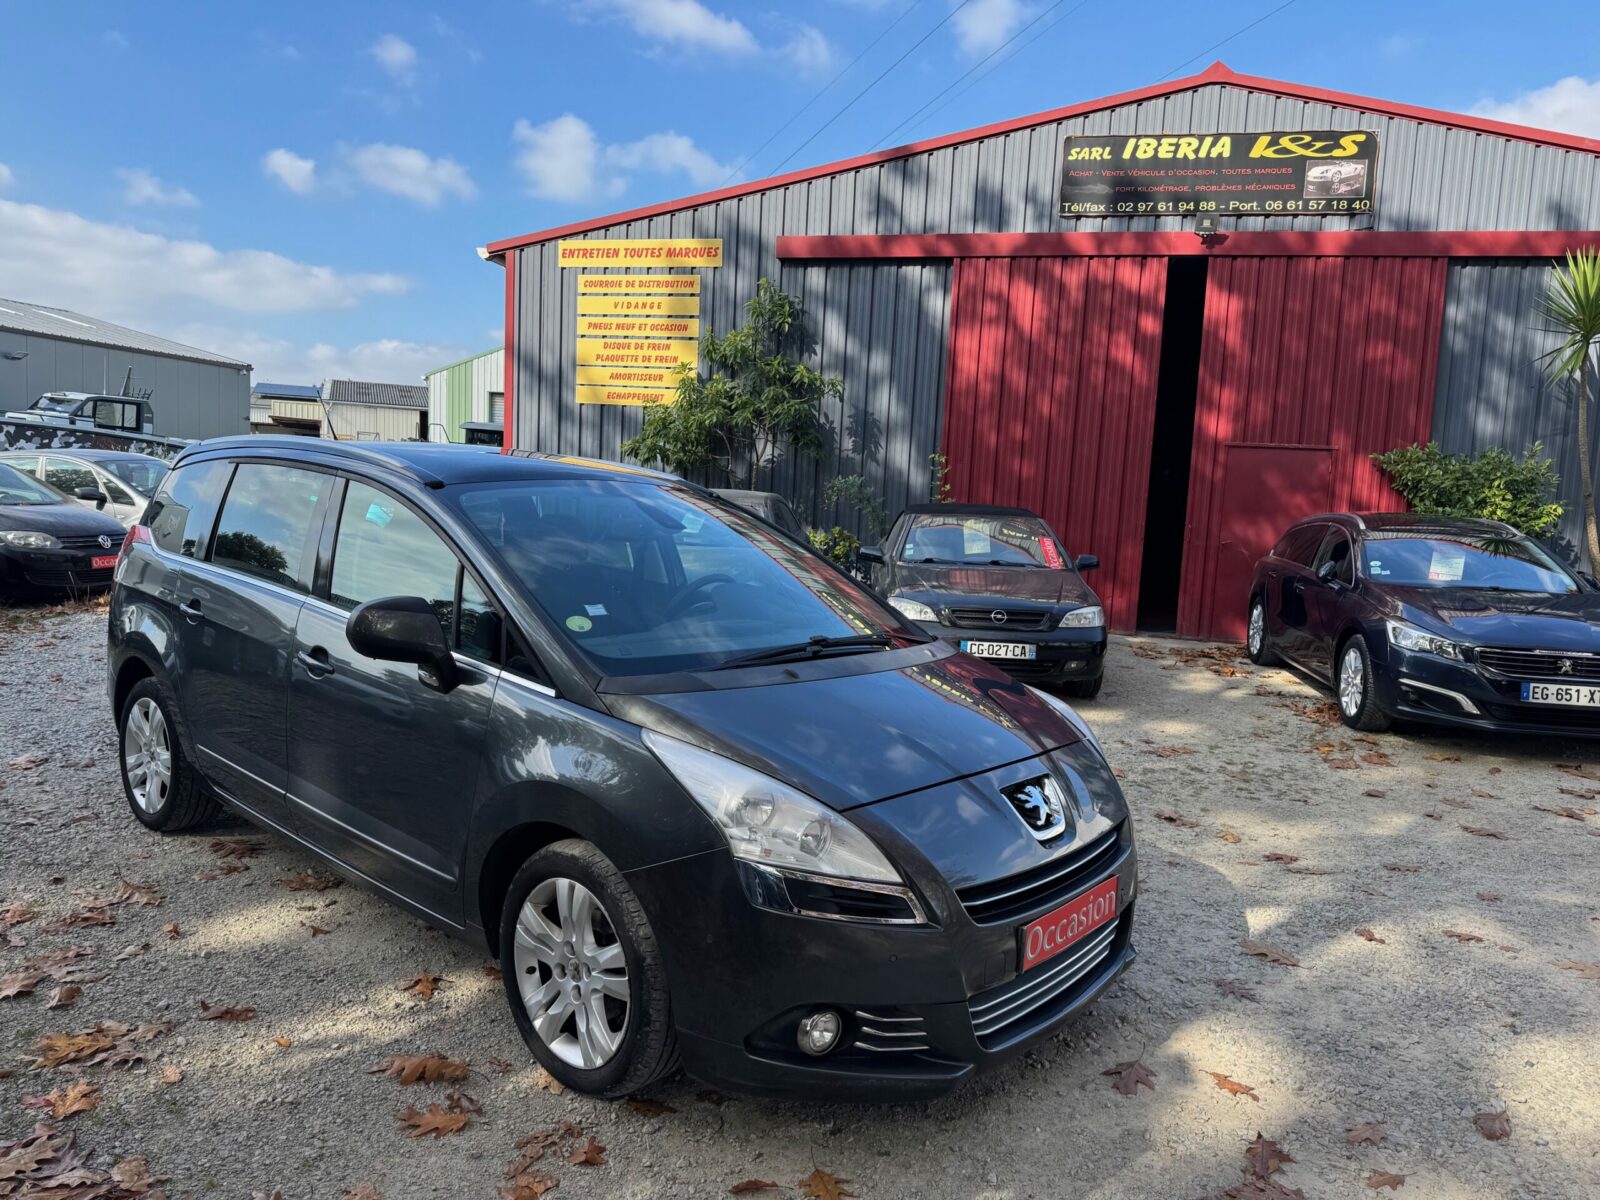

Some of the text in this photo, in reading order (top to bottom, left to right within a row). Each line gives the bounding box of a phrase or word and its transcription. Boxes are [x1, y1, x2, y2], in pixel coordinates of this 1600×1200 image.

[1067, 147, 1112, 161] SARL
[1122, 136, 1231, 160] IBERIA
[1255, 167, 1293, 175] MARQUES
[1194, 183, 1242, 192] PROBLÈMES
[1245, 182, 1296, 191] MÉCANIQUES
[1062, 202, 1106, 213] Tél/fax
[1117, 202, 1134, 212] 02
[1137, 202, 1154, 212] 97
[1157, 202, 1173, 212] 61
[1178, 201, 1195, 211] 94
[1199, 201, 1216, 211] 88
[1229, 201, 1261, 211] Port.
[1265, 200, 1283, 210] 06
[1286, 200, 1303, 210] 61
[1308, 200, 1325, 210] 57
[1332, 200, 1348, 210] 18
[1352, 200, 1370, 210] 40
[561, 247, 719, 259] ENTRETIEN TOUTES MARQUES
[583, 280, 695, 288] COURROIE DE DISTRIBUTION
[613, 301, 663, 310] VIDANGE
[587, 322, 689, 332] PNEUS NEUF ET OCCASION
[603, 341, 671, 351] DISQUE DE FREIN
[595, 354, 679, 364] PLAQUETTE DE FREIN
[609, 372, 664, 382] AMORTISSEUR
[606, 391, 665, 401] ECHAPPEMENT
[969, 642, 1027, 658] CG-027-CA
[1026, 888, 1117, 961] Occasion
